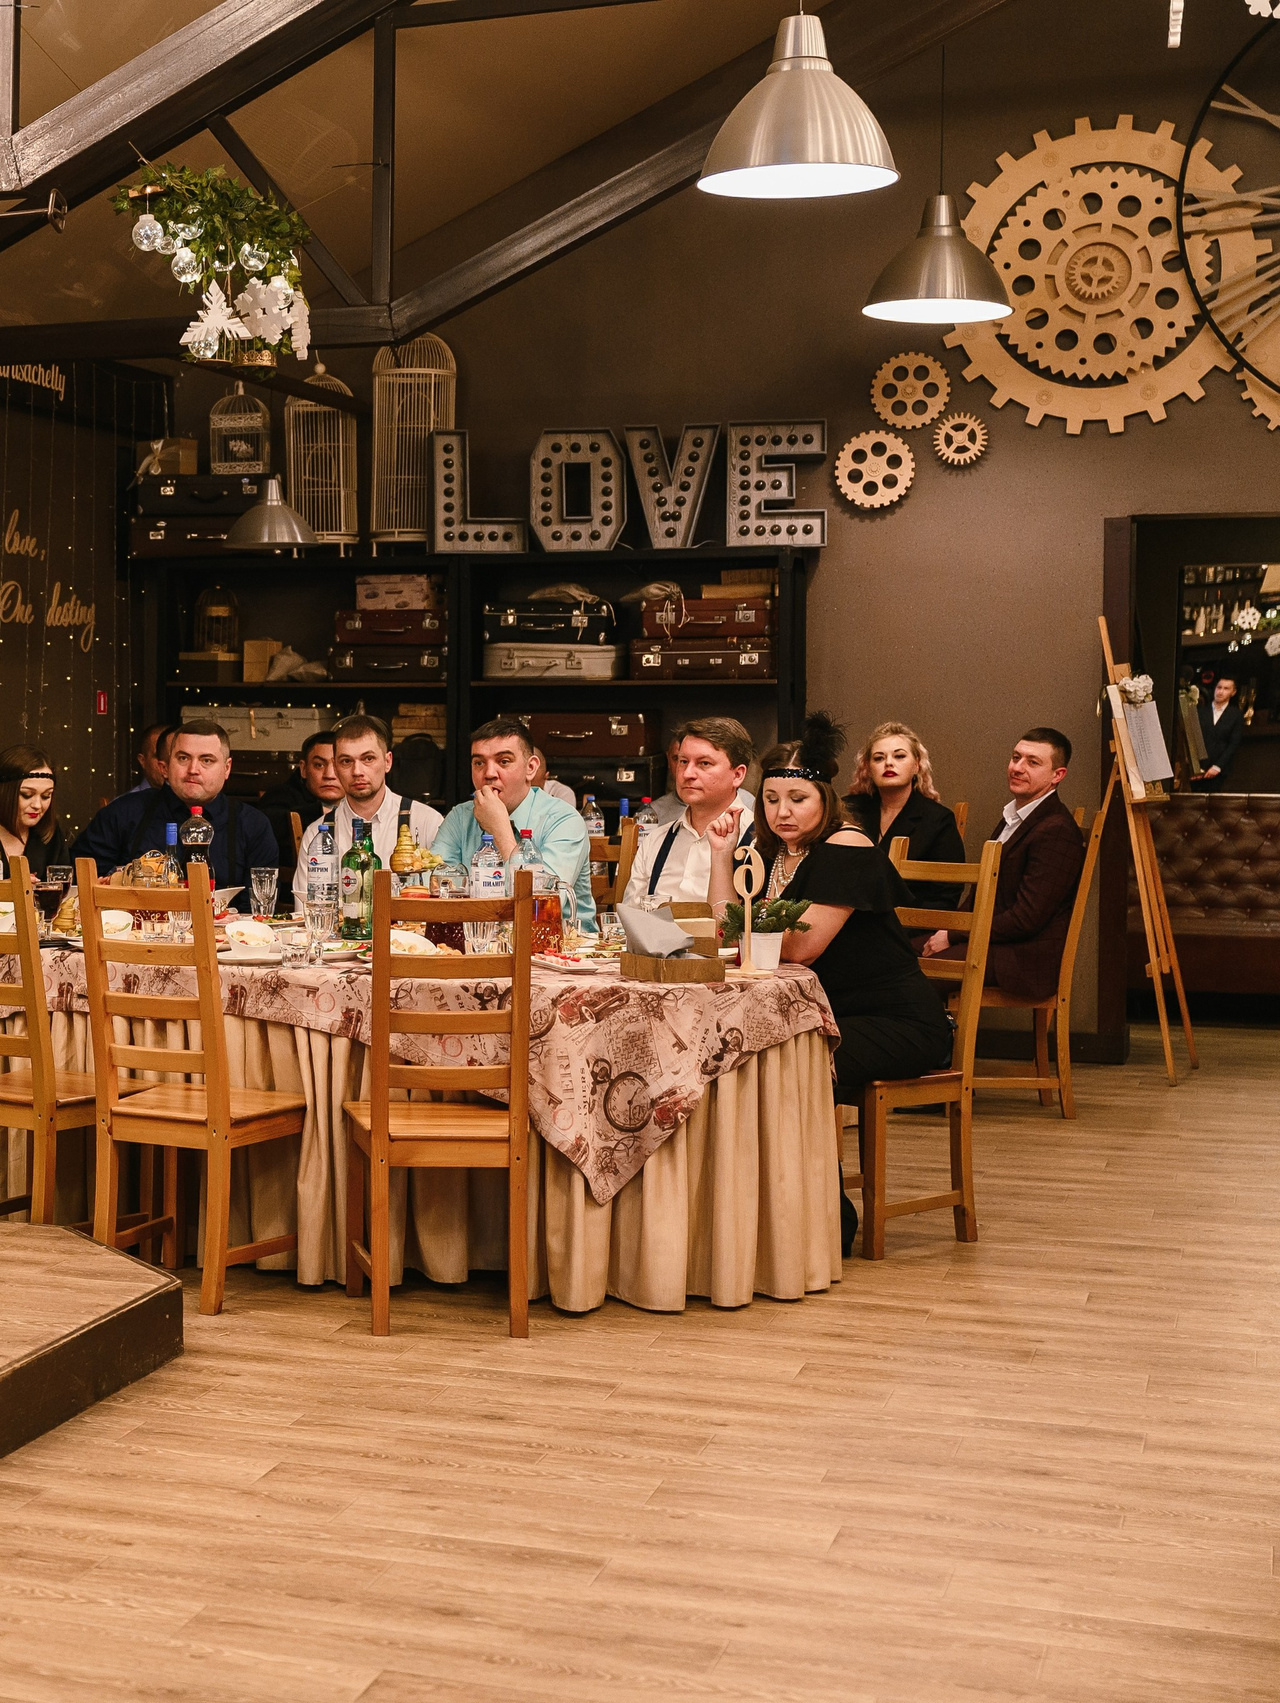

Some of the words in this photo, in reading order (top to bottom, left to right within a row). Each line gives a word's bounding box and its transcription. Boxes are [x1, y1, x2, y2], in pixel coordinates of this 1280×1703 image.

[426, 418, 828, 554] LOVE
[5, 509, 46, 561] love,
[46, 582, 96, 653] destiny
